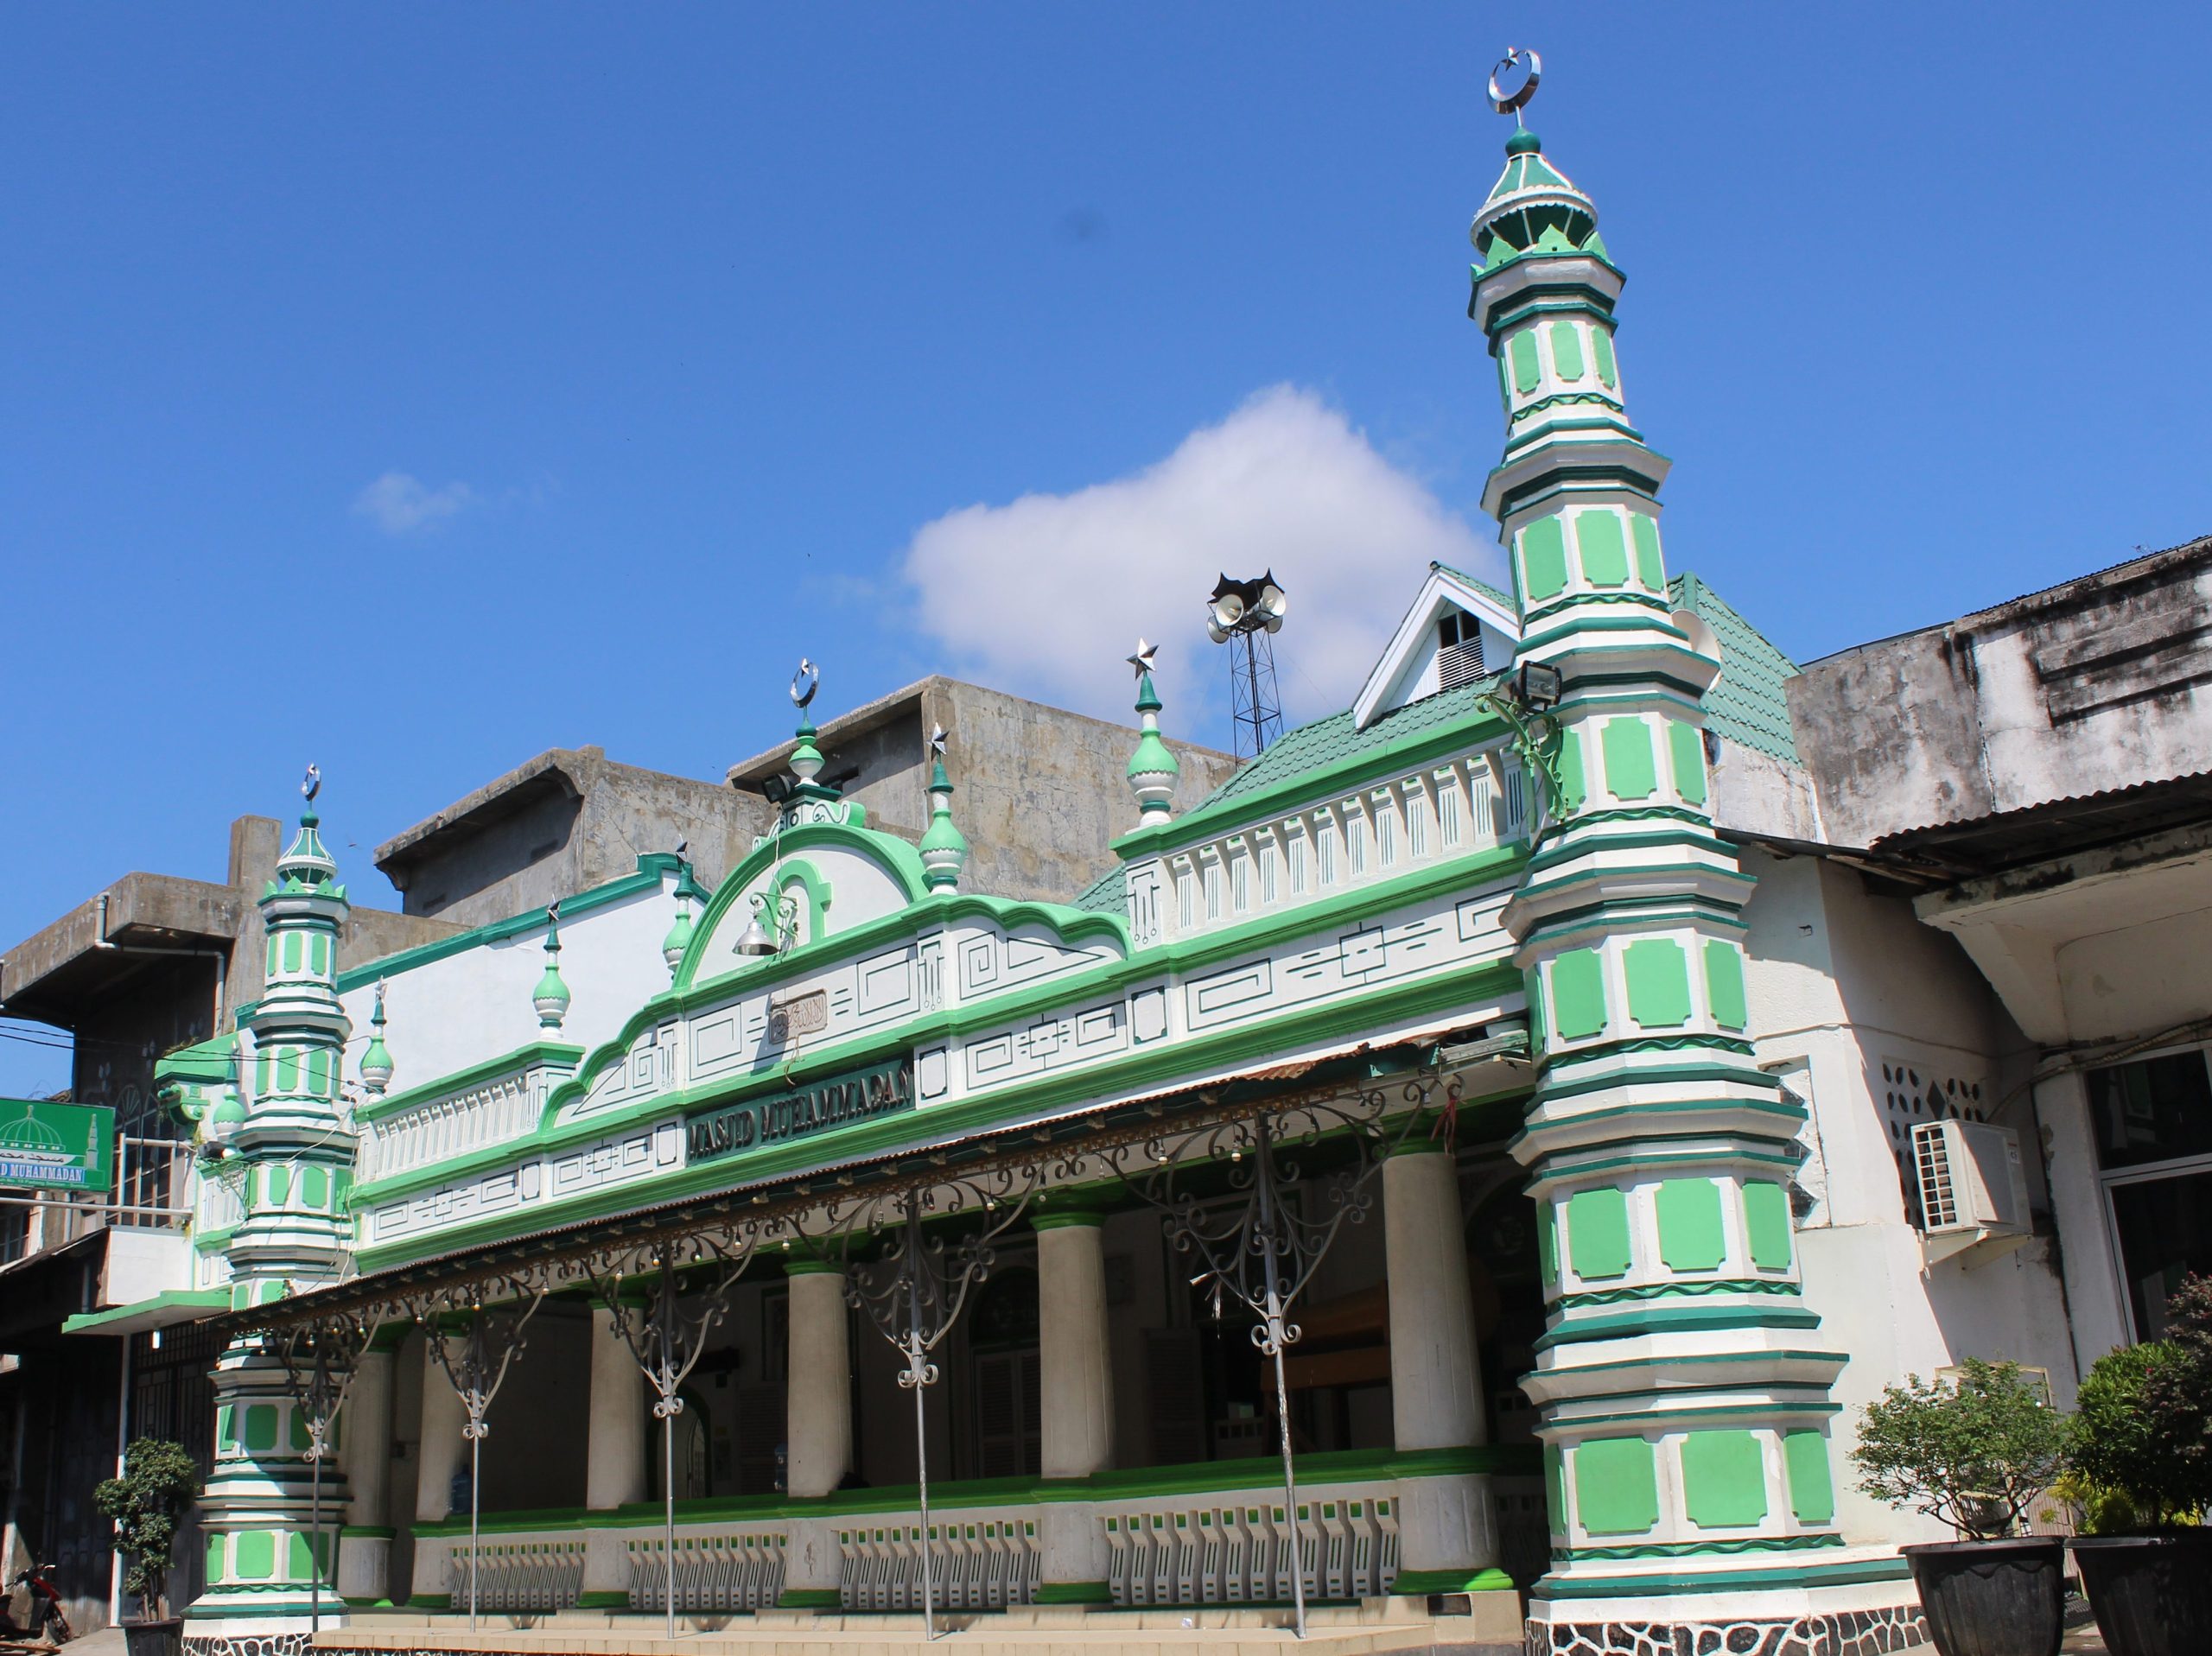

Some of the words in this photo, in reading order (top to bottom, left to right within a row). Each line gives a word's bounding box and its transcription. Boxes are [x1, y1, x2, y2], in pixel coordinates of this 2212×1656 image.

[689, 1109, 755, 1160] MASJID
[760, 1067, 914, 1142] MUHAMMADAN
[10, 1164, 83, 1182] MUHAMMADAN
